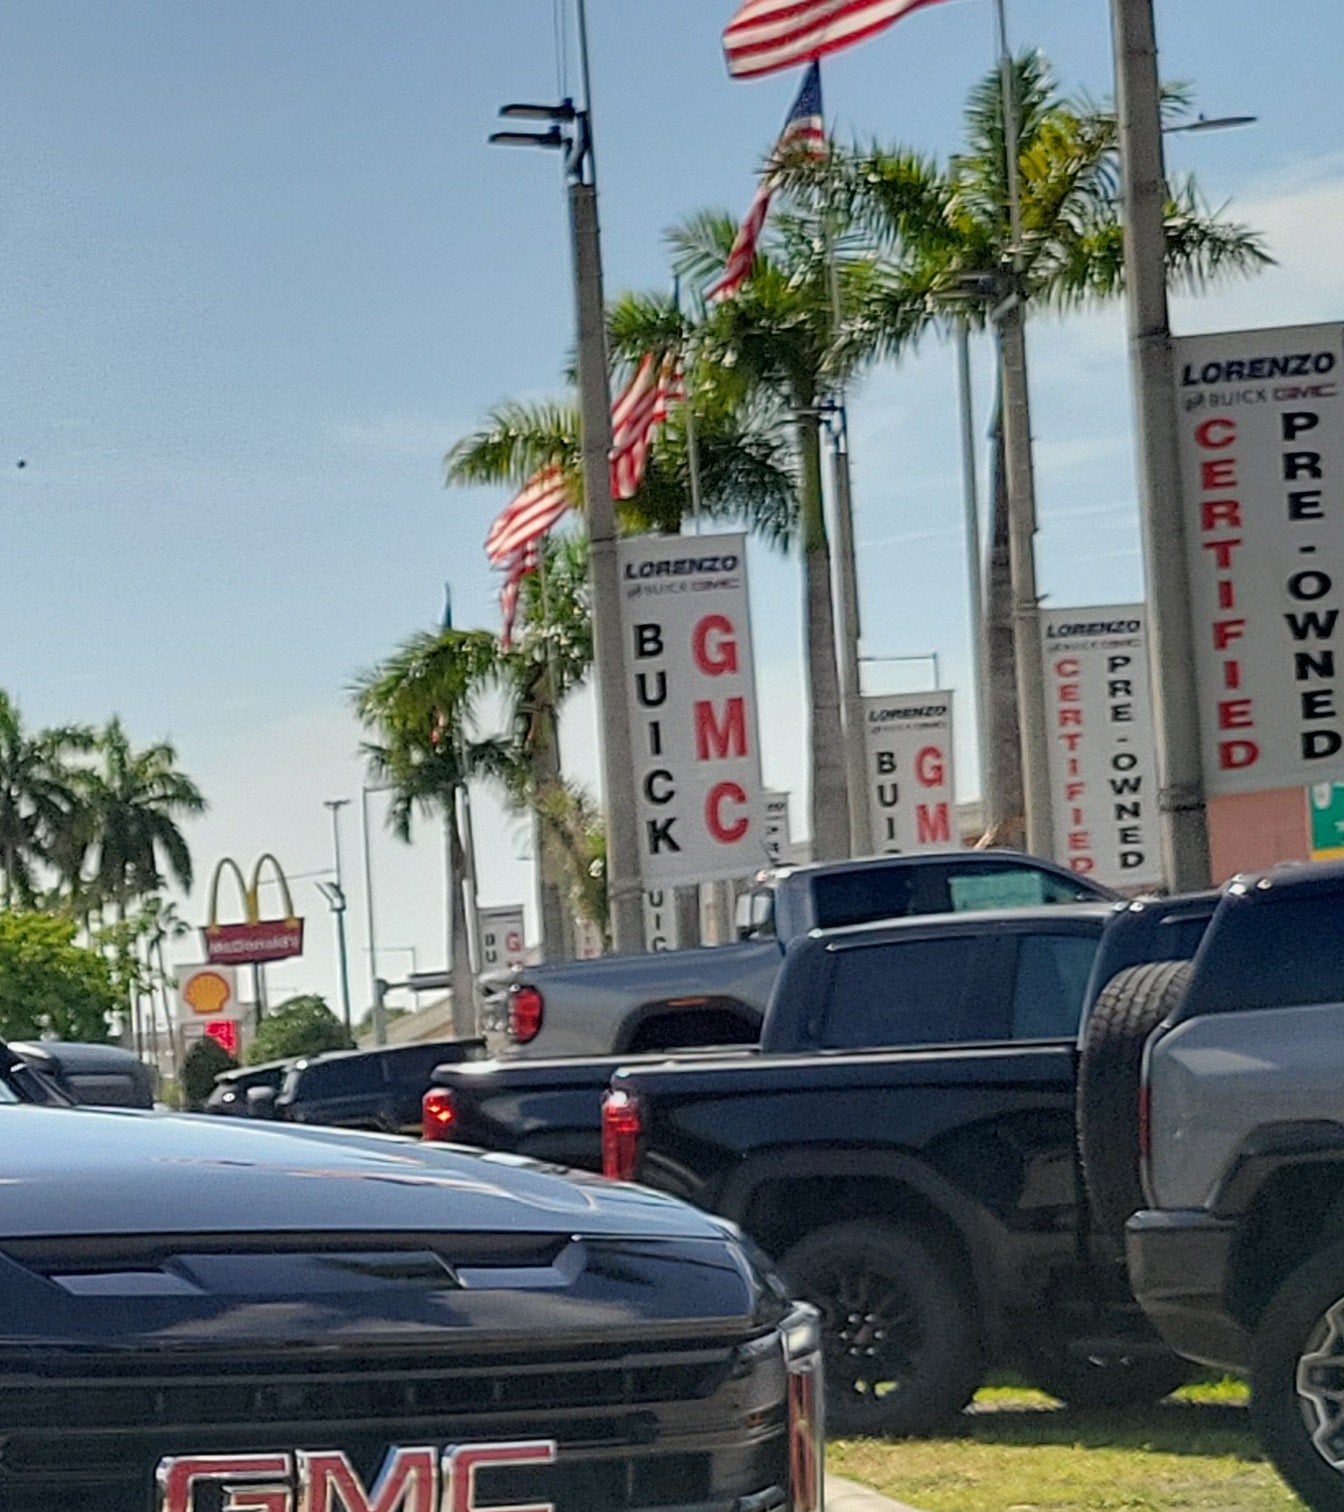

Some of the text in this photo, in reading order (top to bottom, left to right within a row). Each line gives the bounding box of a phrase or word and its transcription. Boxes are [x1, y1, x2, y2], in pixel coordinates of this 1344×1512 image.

[1181, 352, 1337, 387] LORENZO
[1208, 388, 1268, 408] BUICK
[624, 555, 739, 580] LORENZO
[1194, 417, 1260, 771] CERTIFIED
[1047, 620, 1142, 638] LORENZO
[633, 622, 682, 855] BUICK
[691, 613, 750, 844] GMC
[1054, 658, 1095, 874] CERTIFIED
[876, 751, 903, 854] BUI
[914, 745, 950, 845] GM
